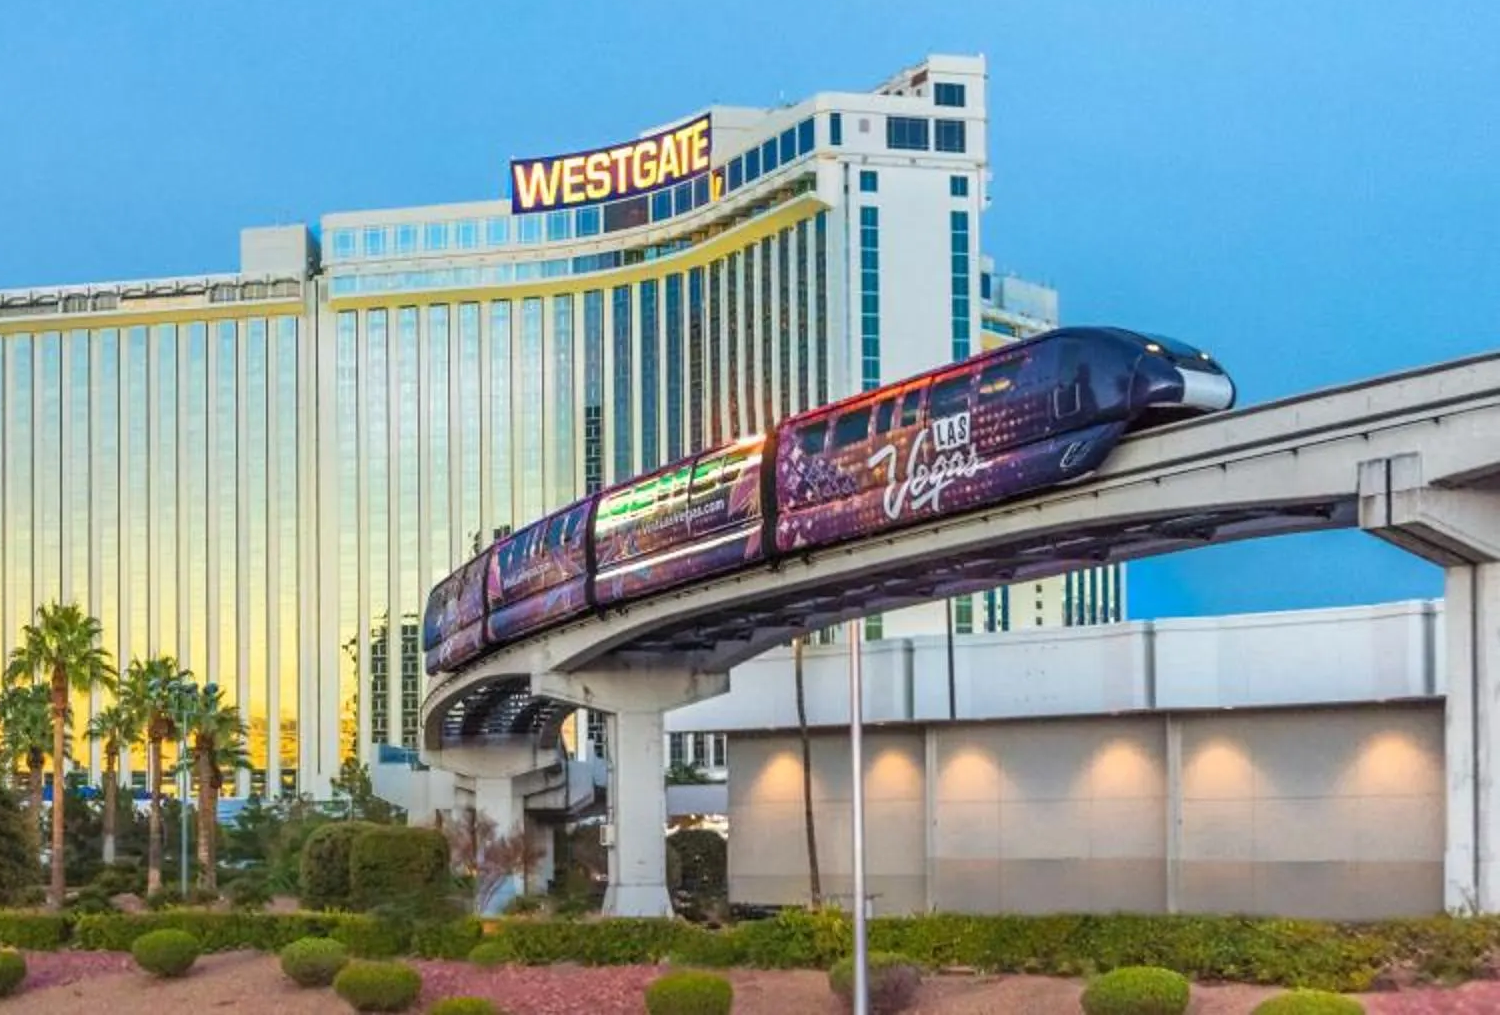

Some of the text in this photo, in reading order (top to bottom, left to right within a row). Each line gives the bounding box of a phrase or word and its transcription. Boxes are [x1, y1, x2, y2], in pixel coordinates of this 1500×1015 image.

[514, 118, 710, 209] WESTGATE
[867, 428, 993, 520] Vegas
[935, 416, 968, 447] LAS
